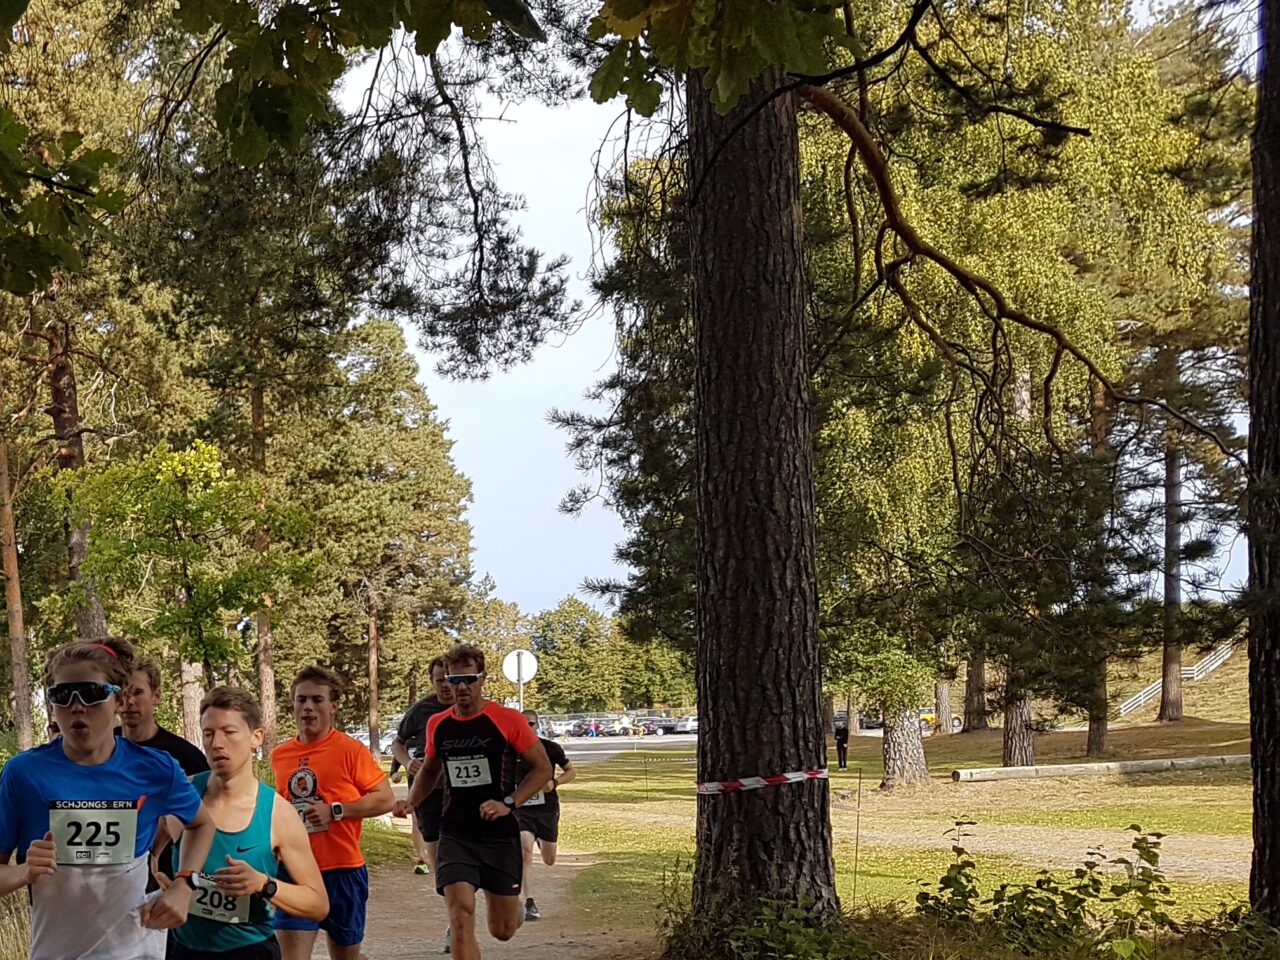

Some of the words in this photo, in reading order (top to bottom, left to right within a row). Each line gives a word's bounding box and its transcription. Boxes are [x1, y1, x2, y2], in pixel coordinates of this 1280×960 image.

[454, 764, 482, 779] 213
[66, 820, 121, 848] 225
[195, 886, 237, 912] 208
